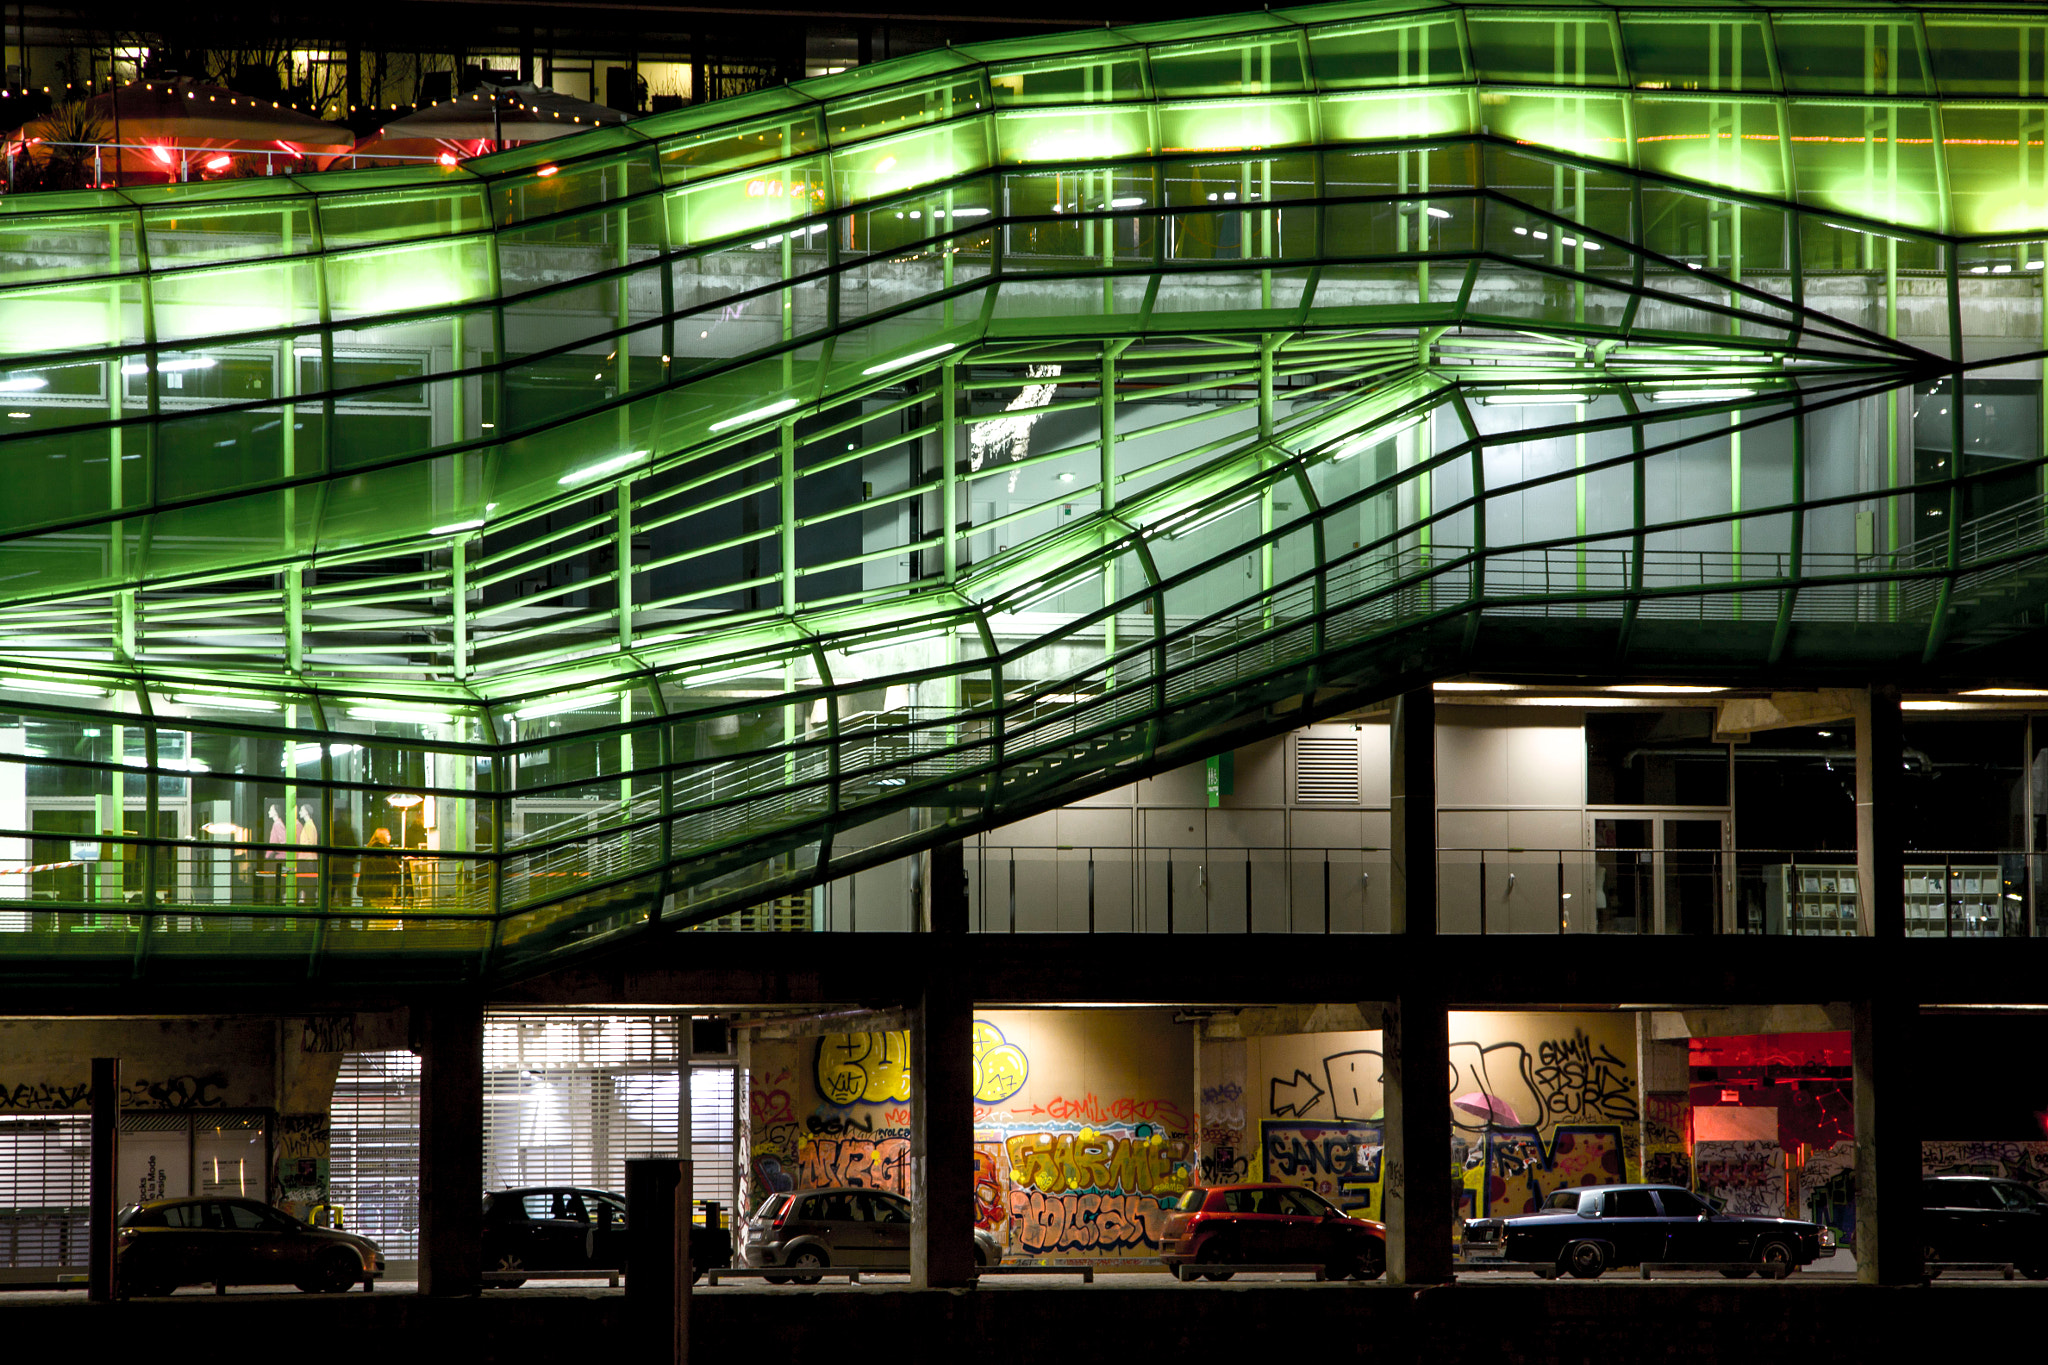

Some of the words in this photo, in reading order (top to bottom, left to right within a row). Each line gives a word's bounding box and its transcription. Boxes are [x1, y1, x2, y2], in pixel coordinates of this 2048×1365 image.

[147, 1155, 156, 1181] Mode
[147, 1183, 155, 1192] la
[156, 1169, 166, 1200] Design
